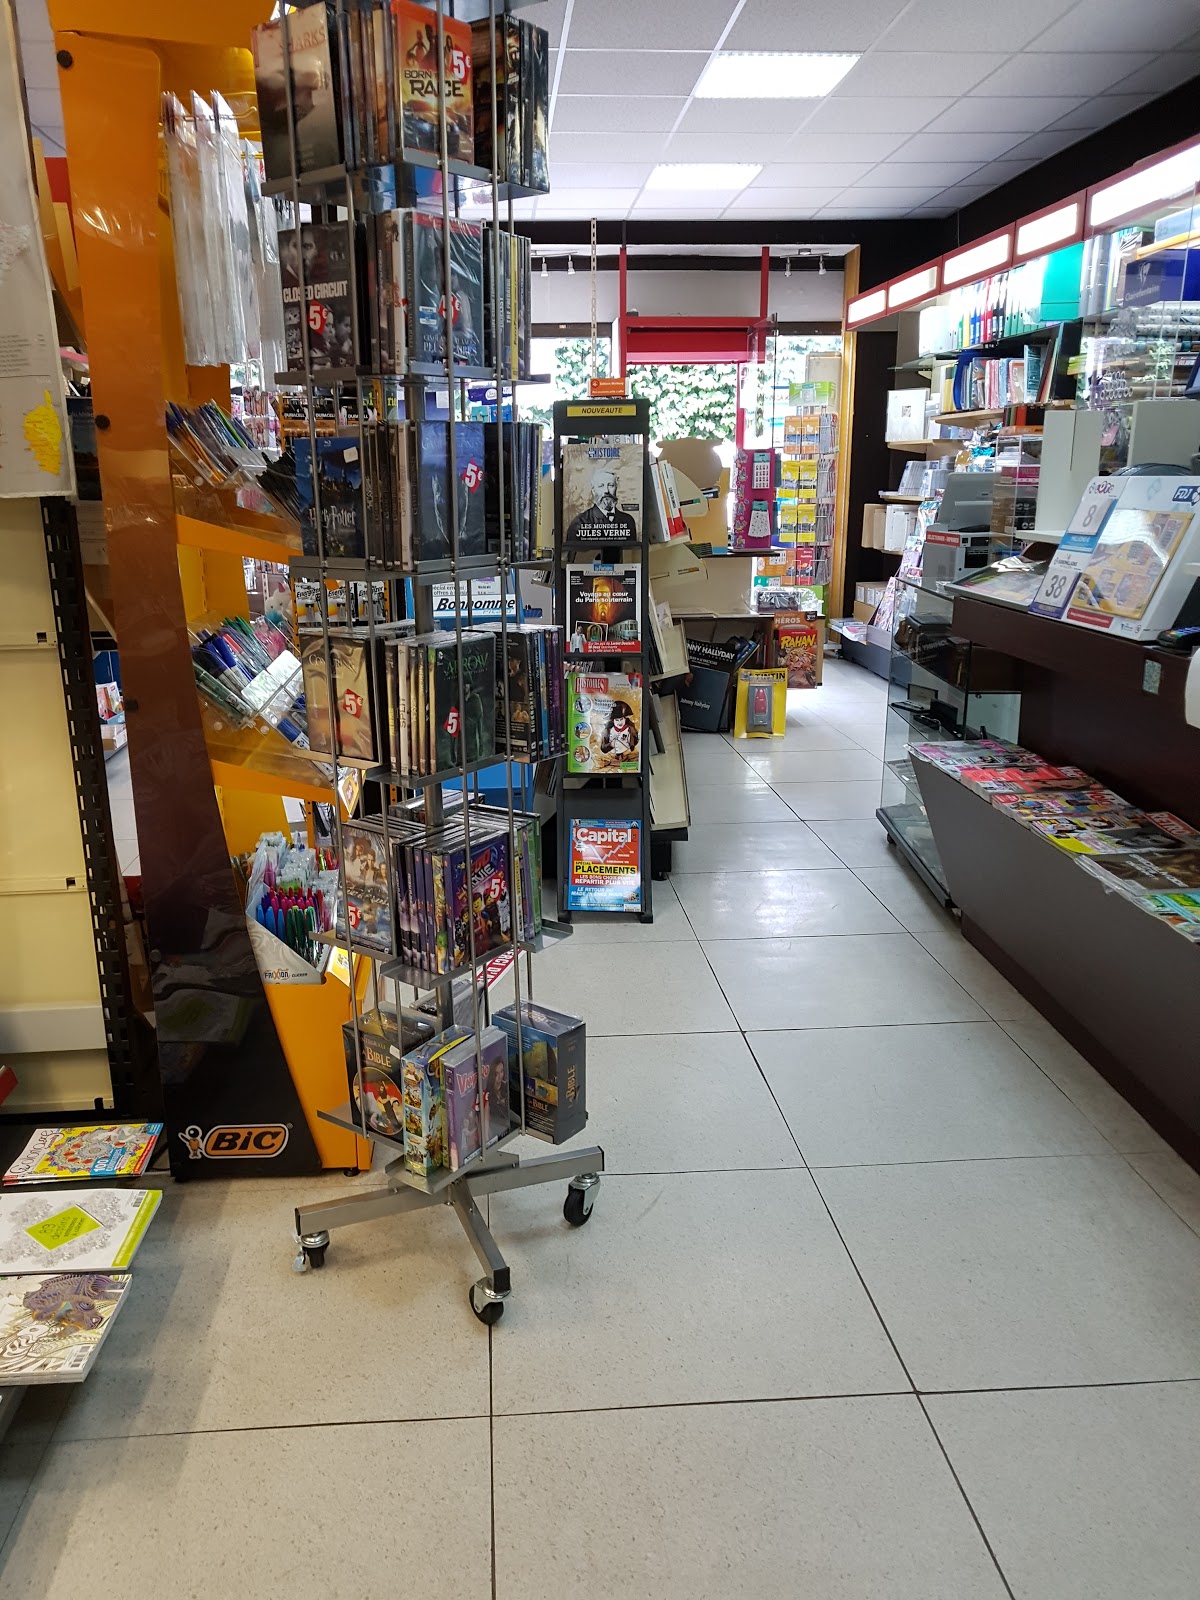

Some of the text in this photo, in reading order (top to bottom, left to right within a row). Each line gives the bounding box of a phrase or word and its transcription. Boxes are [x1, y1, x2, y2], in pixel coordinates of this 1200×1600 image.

[453, 50, 471, 79] 5€
[404, 70, 432, 79] BORN
[410, 80, 464, 98] RACE
[314, 280, 348, 299] CIRCUIT
[309, 305, 328, 330] 5€
[464, 463, 484, 487] 5€
[1174, 487, 1193, 500] FDJ
[1082, 504, 1097, 528] 8
[576, 529, 631, 537] JULES VERNE
[1045, 574, 1067, 598] 38
[687, 643, 702, 652] NNY
[702, 646, 736, 660] HALLYDAY
[780, 635, 816, 649] RAHAN
[345, 694, 363, 715] 5€
[577, 827, 632, 844] Capital
[575, 865, 636, 874] PLACEMENTS
[490, 879, 506, 898] 5€
[366, 1047, 392, 1068] BIBLE
